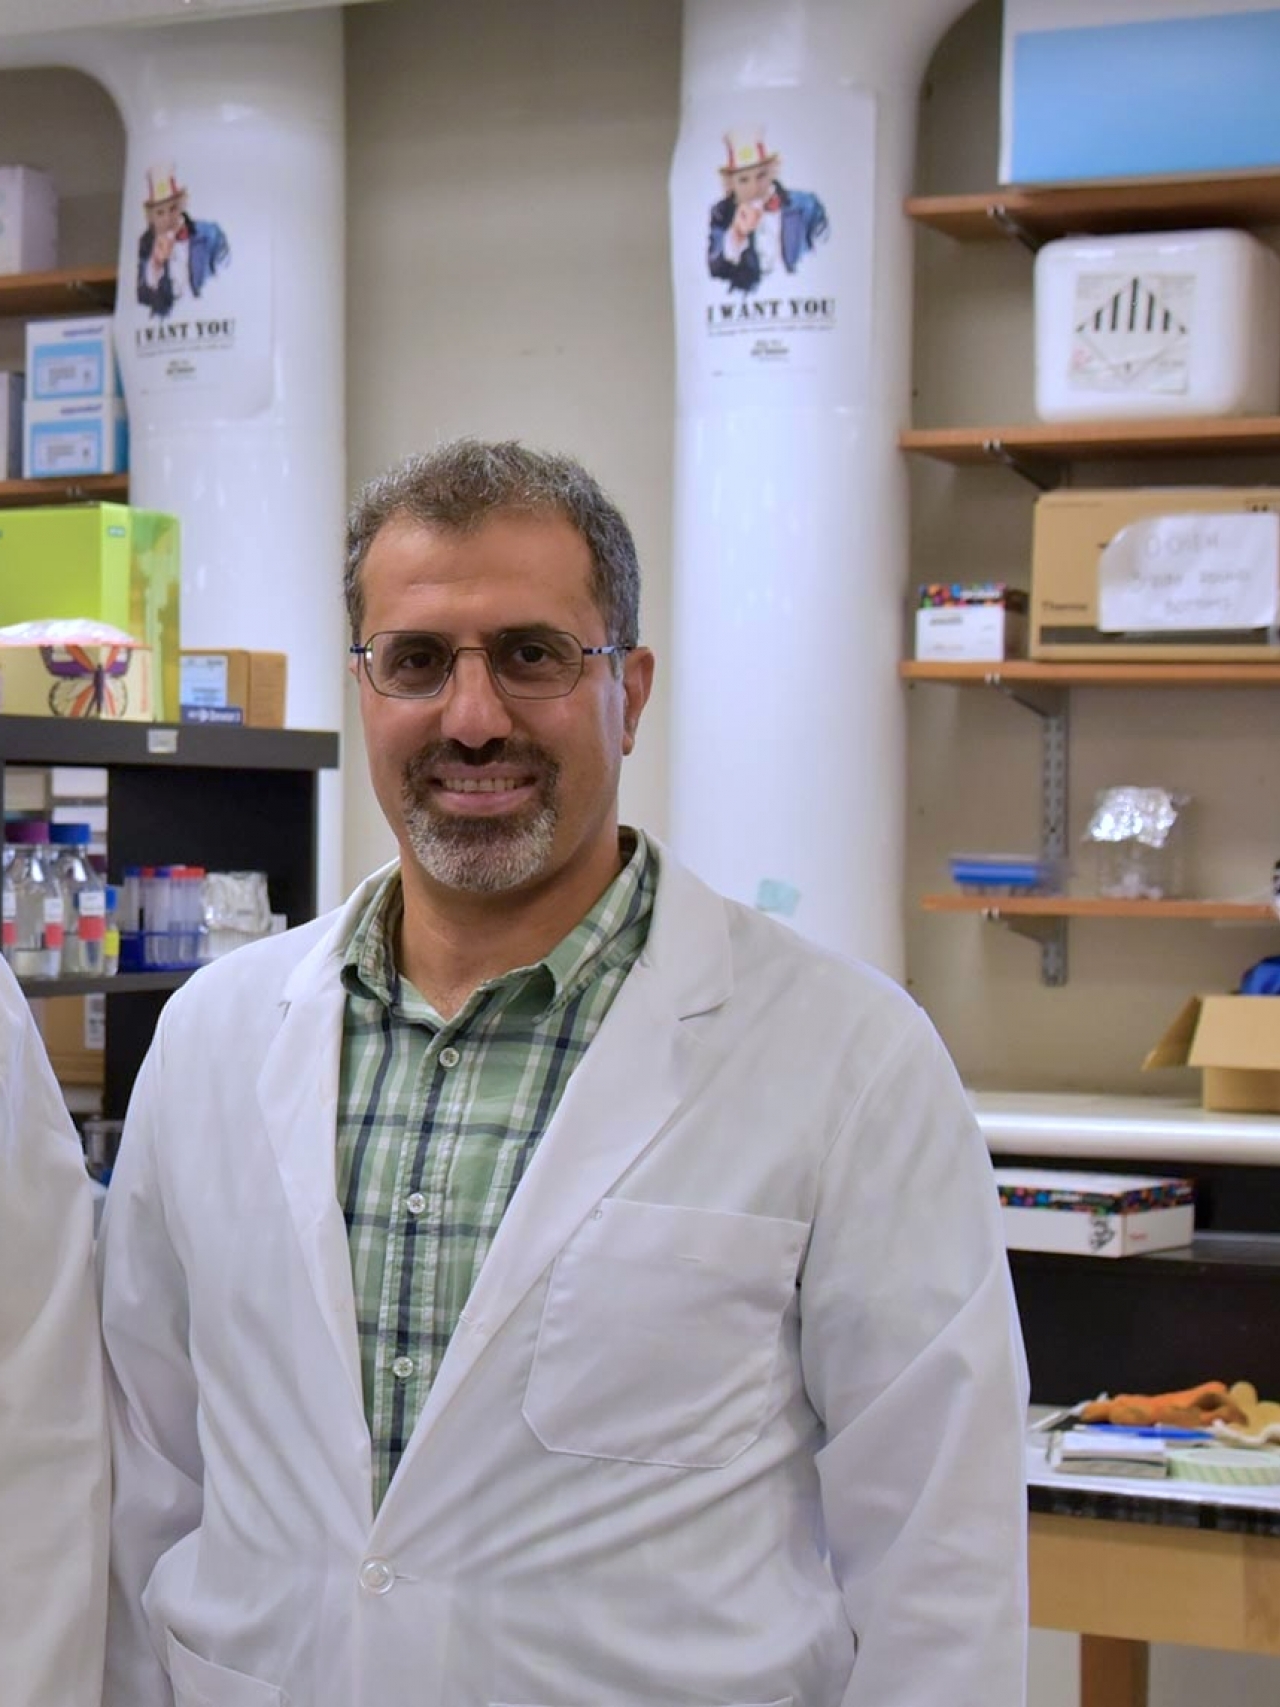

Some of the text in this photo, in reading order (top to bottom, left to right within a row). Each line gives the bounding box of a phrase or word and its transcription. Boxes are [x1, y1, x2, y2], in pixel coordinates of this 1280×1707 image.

[706, 297, 836, 323] I WANT YOU
[144, 321, 189, 343] WANT
[195, 317, 236, 338] YOU
